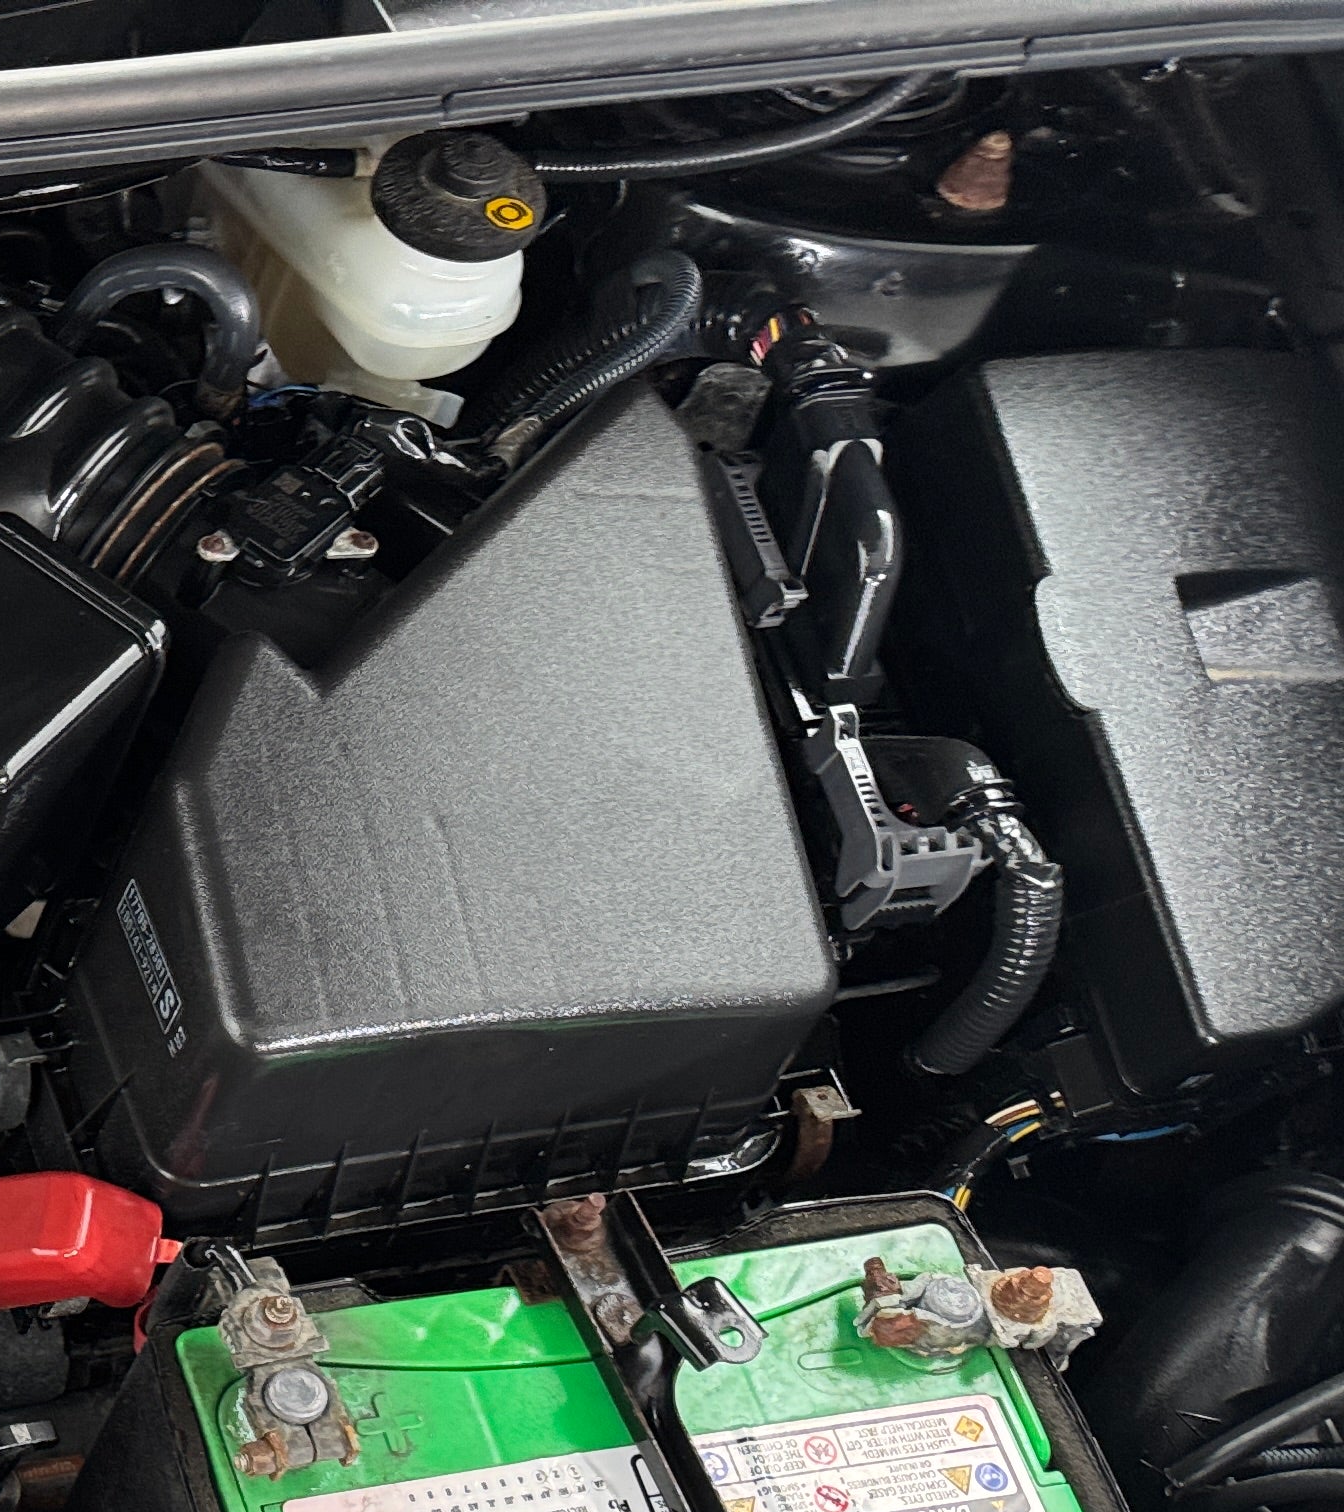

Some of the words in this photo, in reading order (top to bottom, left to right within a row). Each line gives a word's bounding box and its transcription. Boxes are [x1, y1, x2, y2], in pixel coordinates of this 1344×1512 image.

[157, 988, 177, 1018] S
[879, 1423, 903, 1434] HELP
[904, 1416, 946, 1430] MEDICAL
[898, 1431, 923, 1442] WITH
[922, 1427, 951, 1438] ATELY
[843, 1439, 862, 1450] GET
[901, 1443, 924, 1453] EYES
[890, 1471, 918, 1482] CAUSE
[917, 1469, 936, 1478] CAN
[896, 1479, 947, 1494] EXPLOSIVE
[924, 1488, 959, 1501] SHIELD
